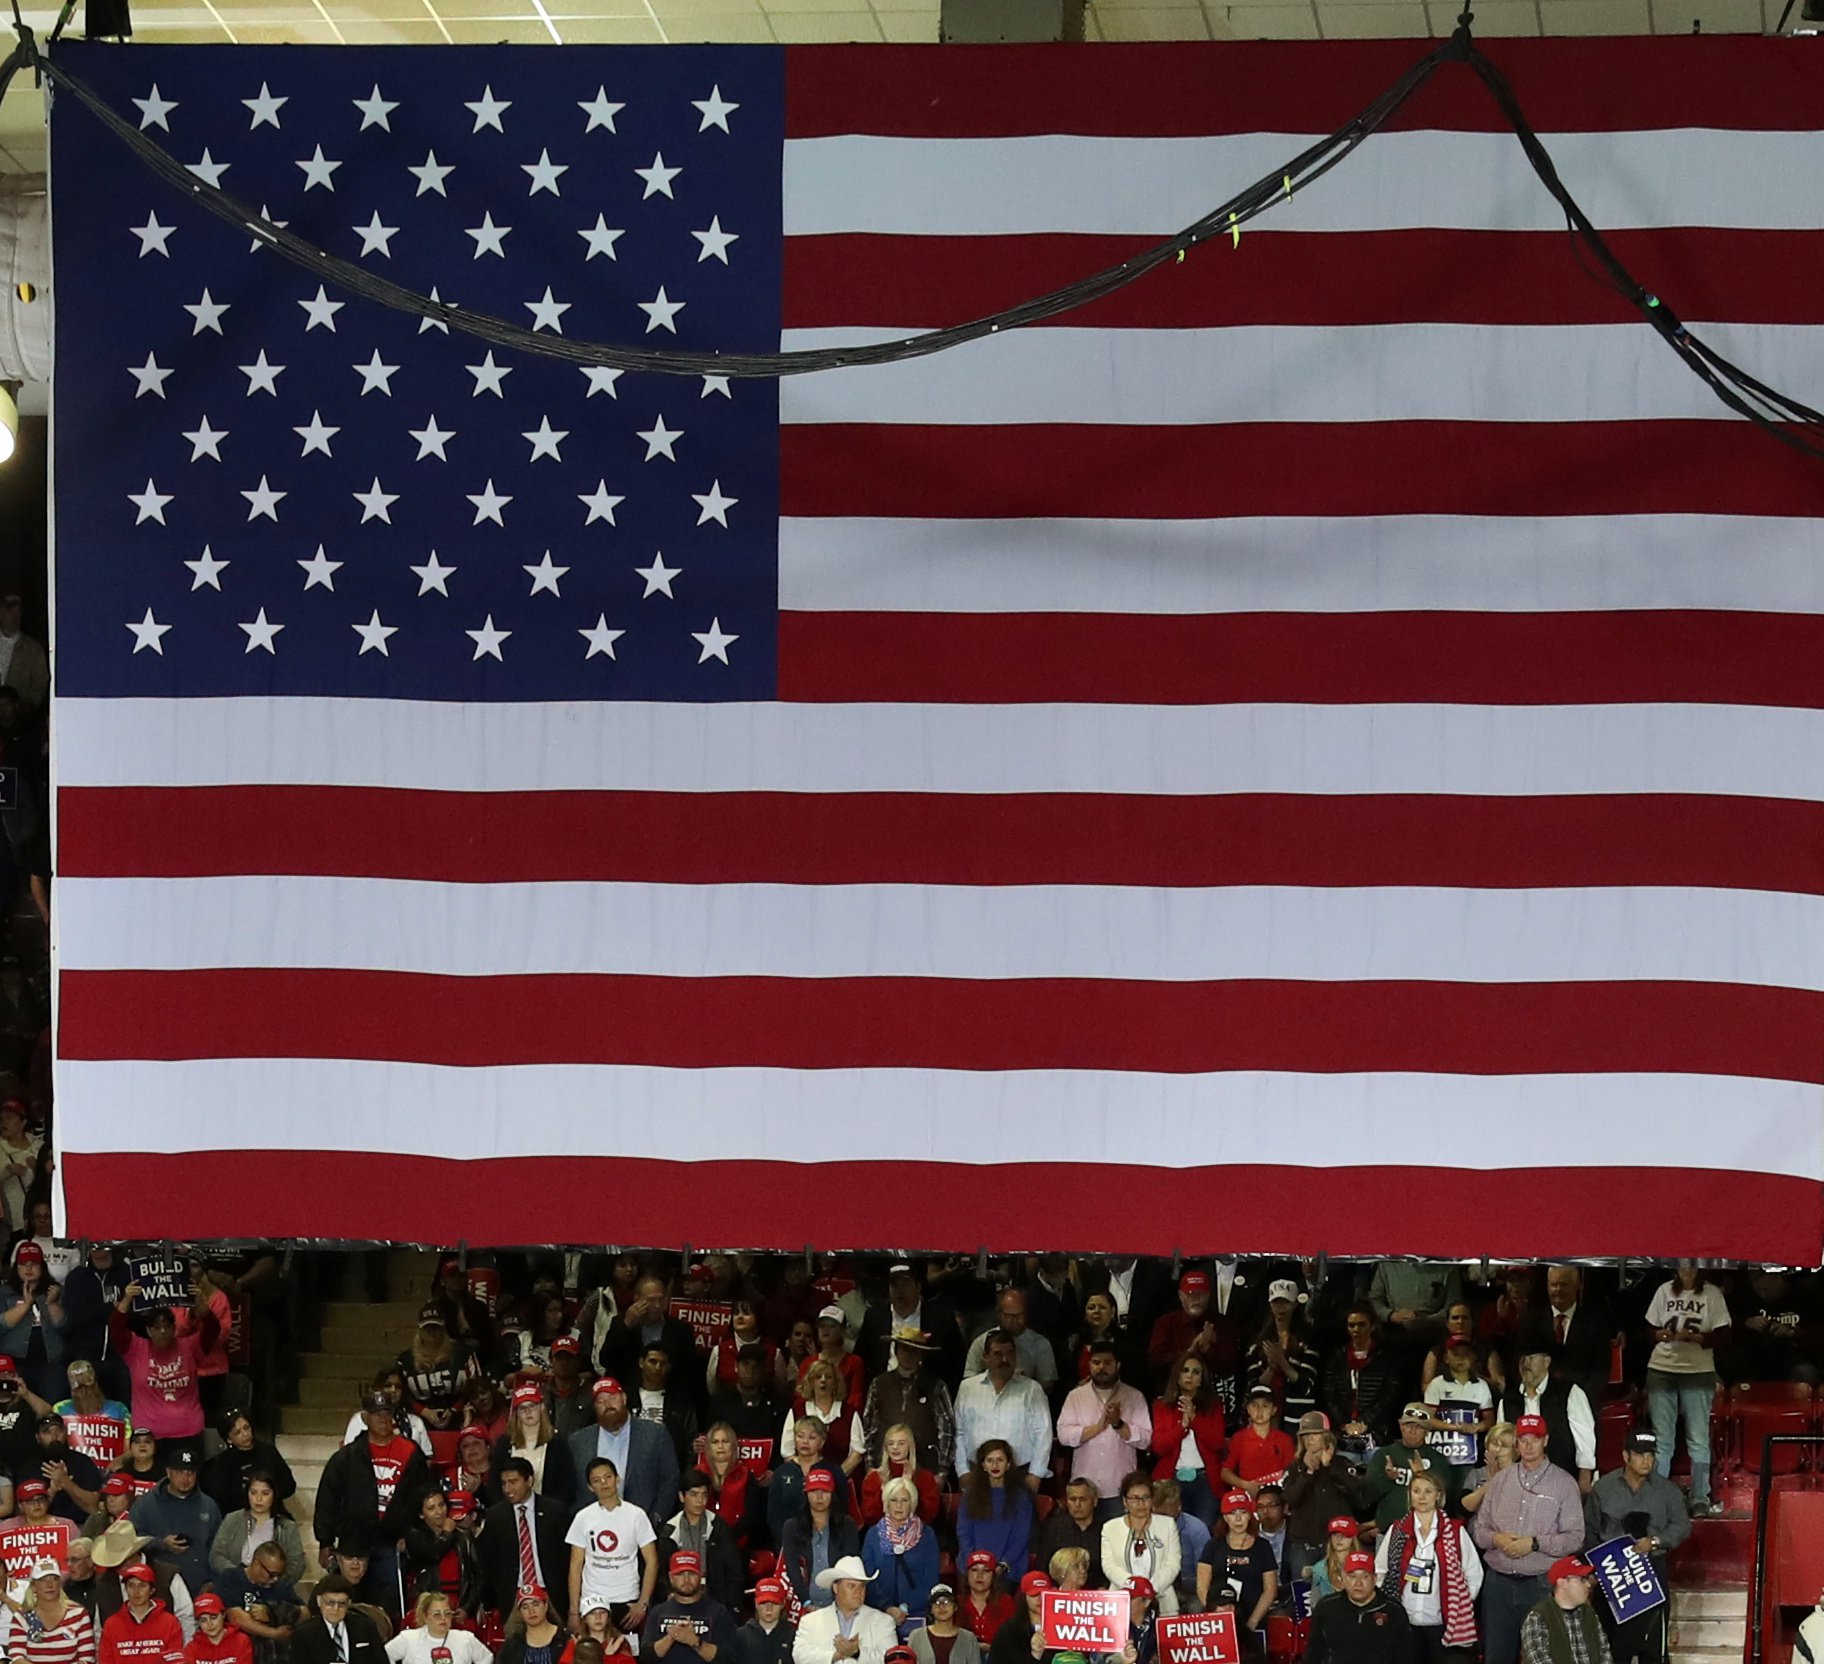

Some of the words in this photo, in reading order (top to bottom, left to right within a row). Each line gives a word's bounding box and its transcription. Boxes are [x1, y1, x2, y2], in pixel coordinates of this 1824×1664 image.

[154, 1276, 173, 1284] THE
[141, 1284, 188, 1301] WALL
[1666, 1300, 1706, 1314] PRAY
[678, 1309, 733, 1326] FINISH
[66, 1422, 119, 1439] FINISH
[85, 1437, 103, 1446] THE
[3, 1531, 58, 1549] FINISH
[19, 1546, 38, 1554] THE
[1601, 1553, 1634, 1610] WALL
[1053, 1599, 1117, 1617] FINISH
[1073, 1616, 1094, 1626] THE
[1166, 1620, 1224, 1638] FINISH
[1055, 1625, 1115, 1643] WALL
[1185, 1637, 1205, 1647] THE
[1170, 1645, 1226, 1664] WALL
